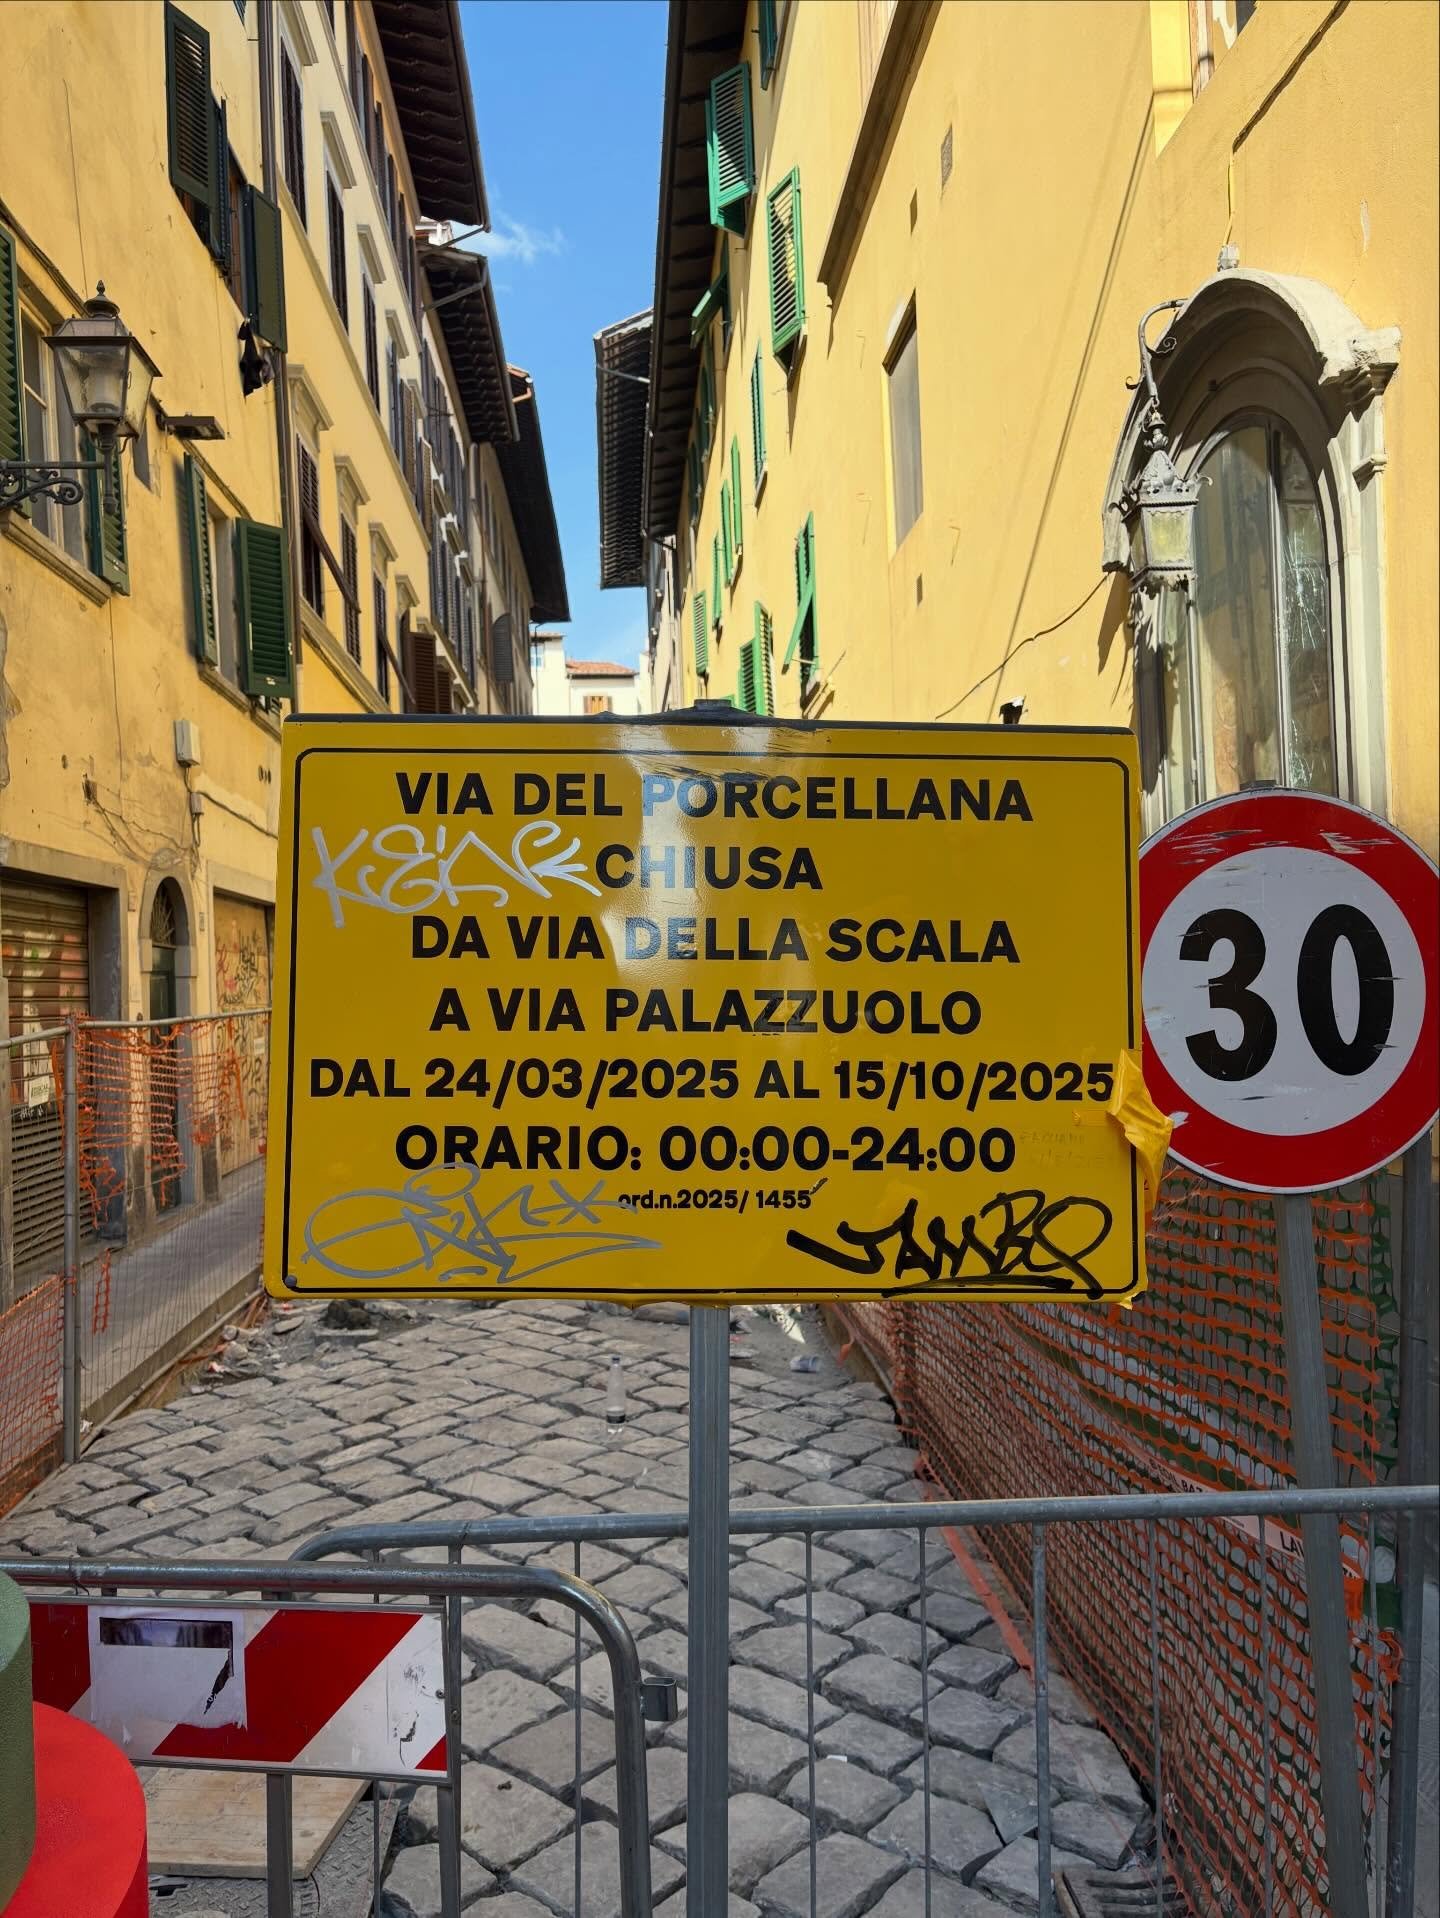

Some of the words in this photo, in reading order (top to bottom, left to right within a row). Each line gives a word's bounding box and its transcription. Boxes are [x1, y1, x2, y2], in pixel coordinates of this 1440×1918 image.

[396, 772, 493, 816] VIA
[514, 773, 622, 817] DEL
[643, 774, 1033, 822] PORCELLANA
[596, 844, 823, 891] CHIUSA
[412, 916, 490, 959] DA
[507, 916, 605, 960] VIA
[624, 917, 809, 961] DELLA
[825, 919, 1020, 964] SCALA
[429, 988, 470, 1032] A
[487, 988, 585, 1032] VIA
[606, 989, 981, 1035] PALAZZUOLO
[1179, 904, 1395, 1082] 30
[311, 1059, 410, 1098] DAL
[425, 1058, 739, 1110] 24/03/2025
[754, 1060, 819, 1099] AL
[834, 1061, 1113, 1112] 15/10/2025
[396, 1125, 642, 1171] ORARIO:
[660, 1126, 1015, 1173] 00:00-24:00
